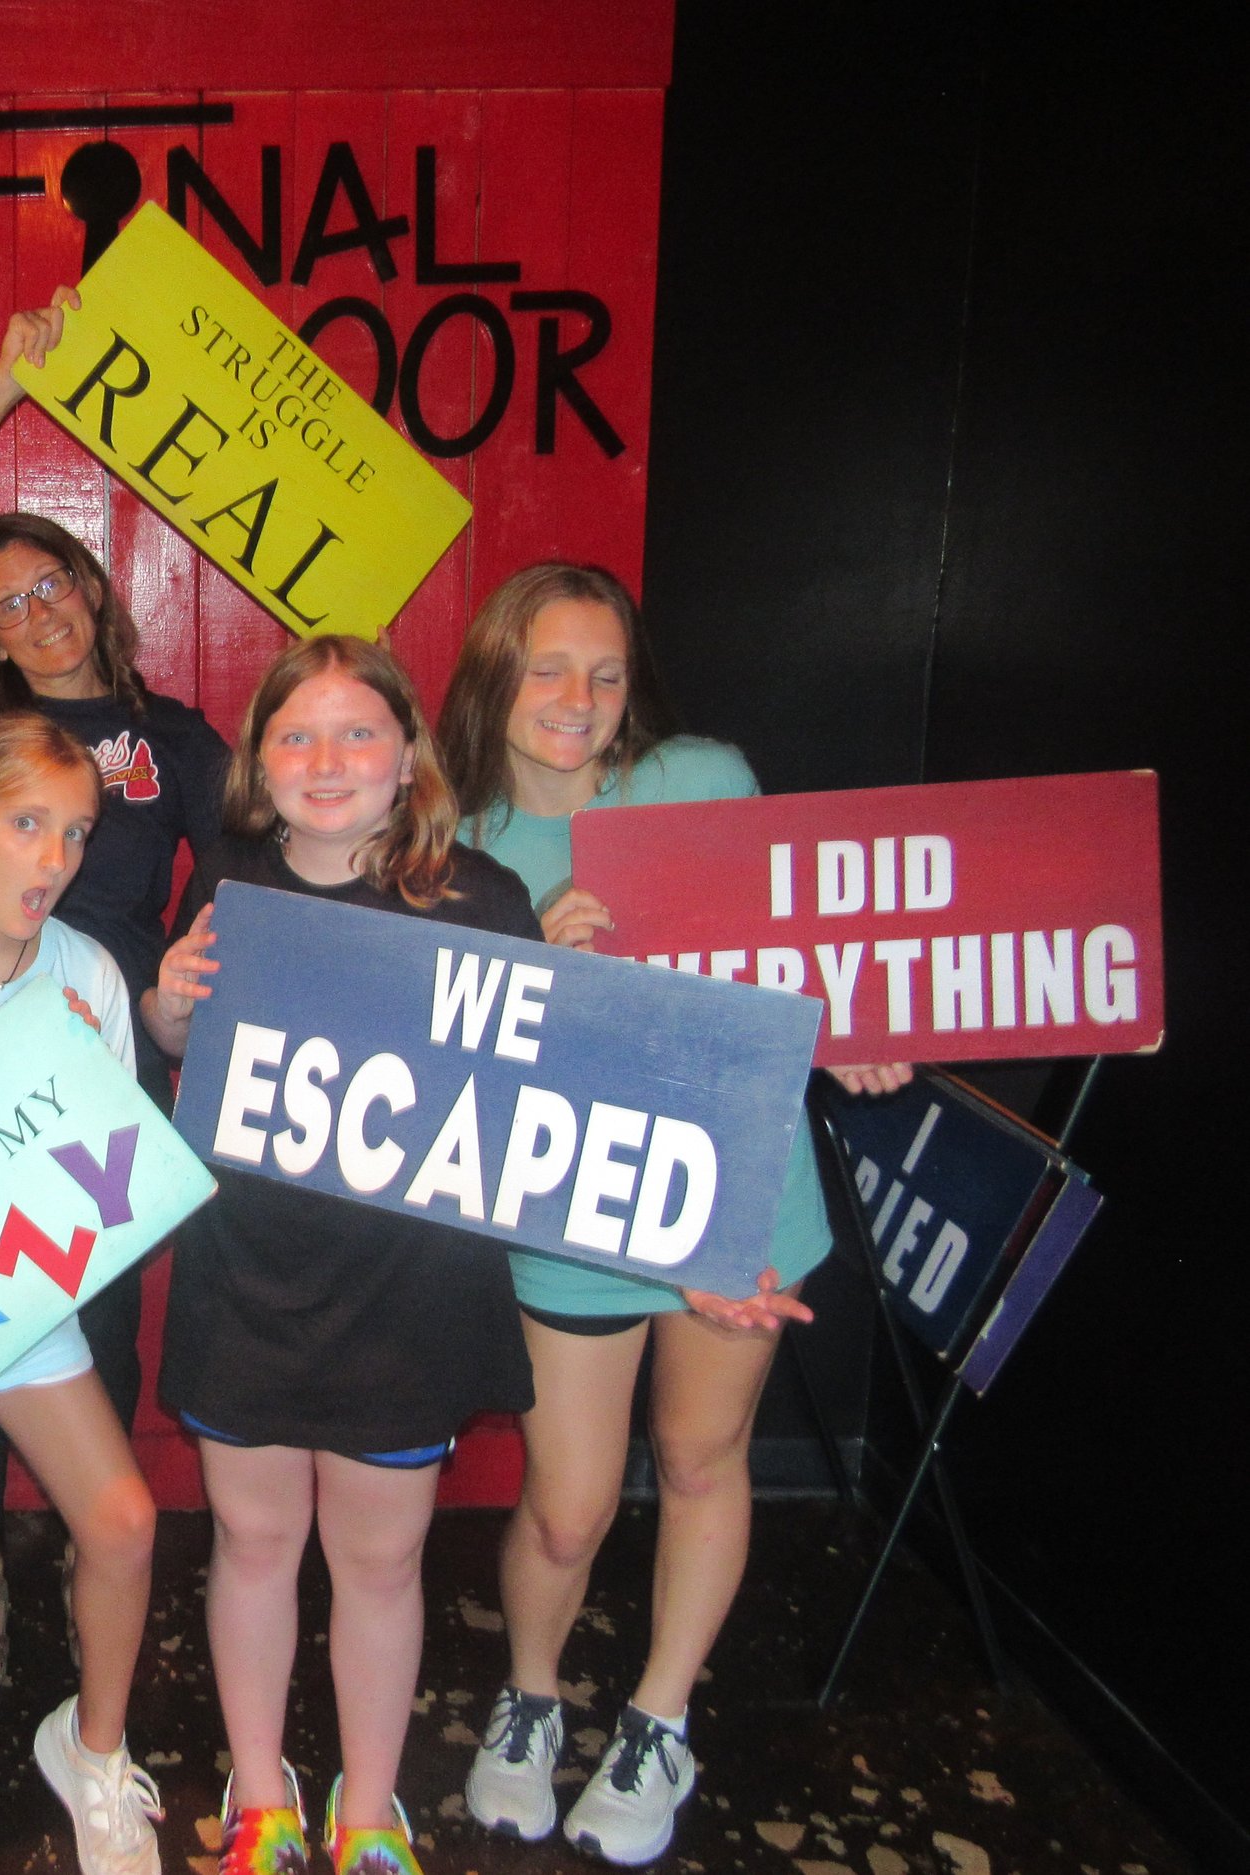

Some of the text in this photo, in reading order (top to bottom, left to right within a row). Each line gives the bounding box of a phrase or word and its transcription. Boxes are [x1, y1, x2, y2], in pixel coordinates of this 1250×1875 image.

[179, 305, 376, 494] STRUGGLE
[237, 407, 278, 450] IS
[268, 331, 342, 412] THE
[297, 289, 626, 460] OOR
[54, 327, 344, 629] REAL
[770, 834, 953, 917] I DID
[430, 947, 554, 1064] WE
[618, 924, 1139, 1038] RYTHING
[212, 1022, 719, 1266] ESCAPED
[901, 1101, 944, 1176] I
[843, 1137, 970, 1316] IED
